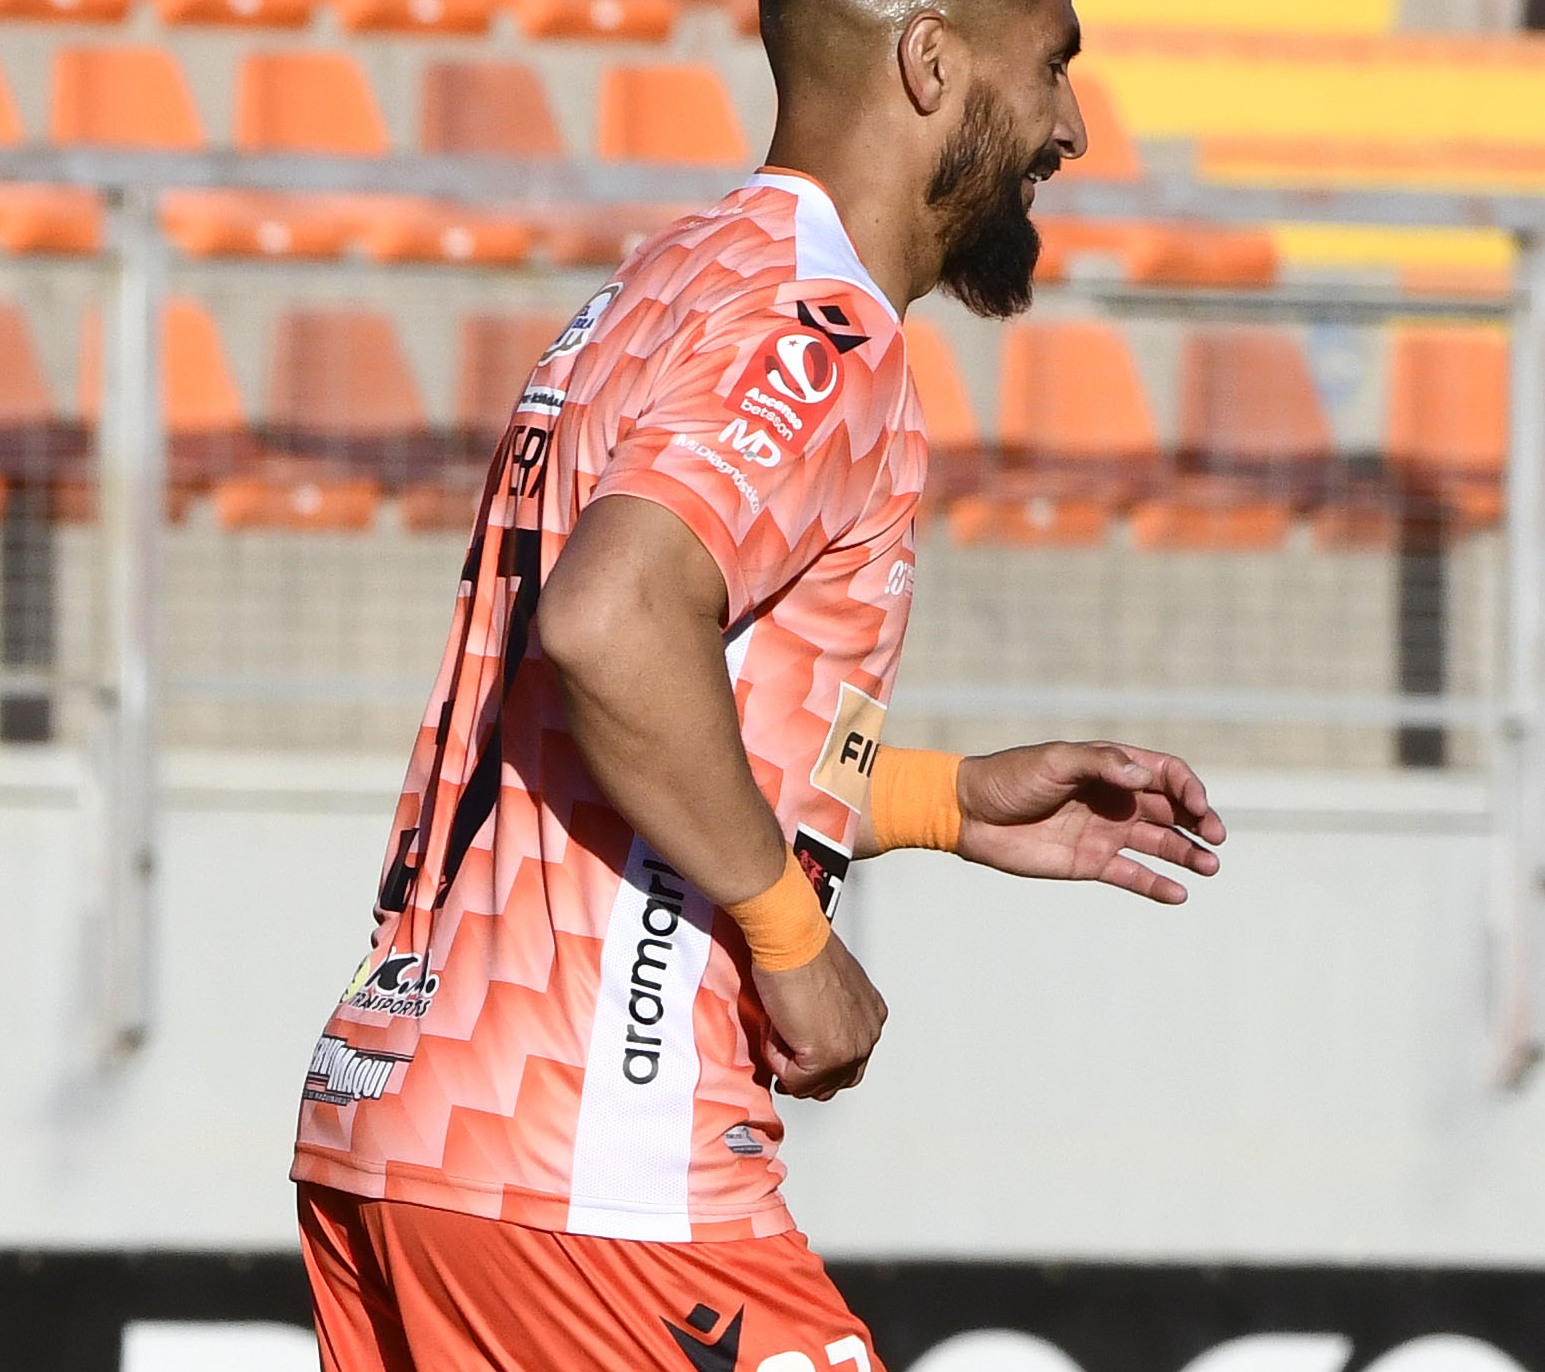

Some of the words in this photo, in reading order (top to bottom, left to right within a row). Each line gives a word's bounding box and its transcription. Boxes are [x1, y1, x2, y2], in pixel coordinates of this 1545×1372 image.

[740, 399, 794, 441] betsson
[745, 387, 803, 431] Ascenso
[718, 418, 781, 467] MD
